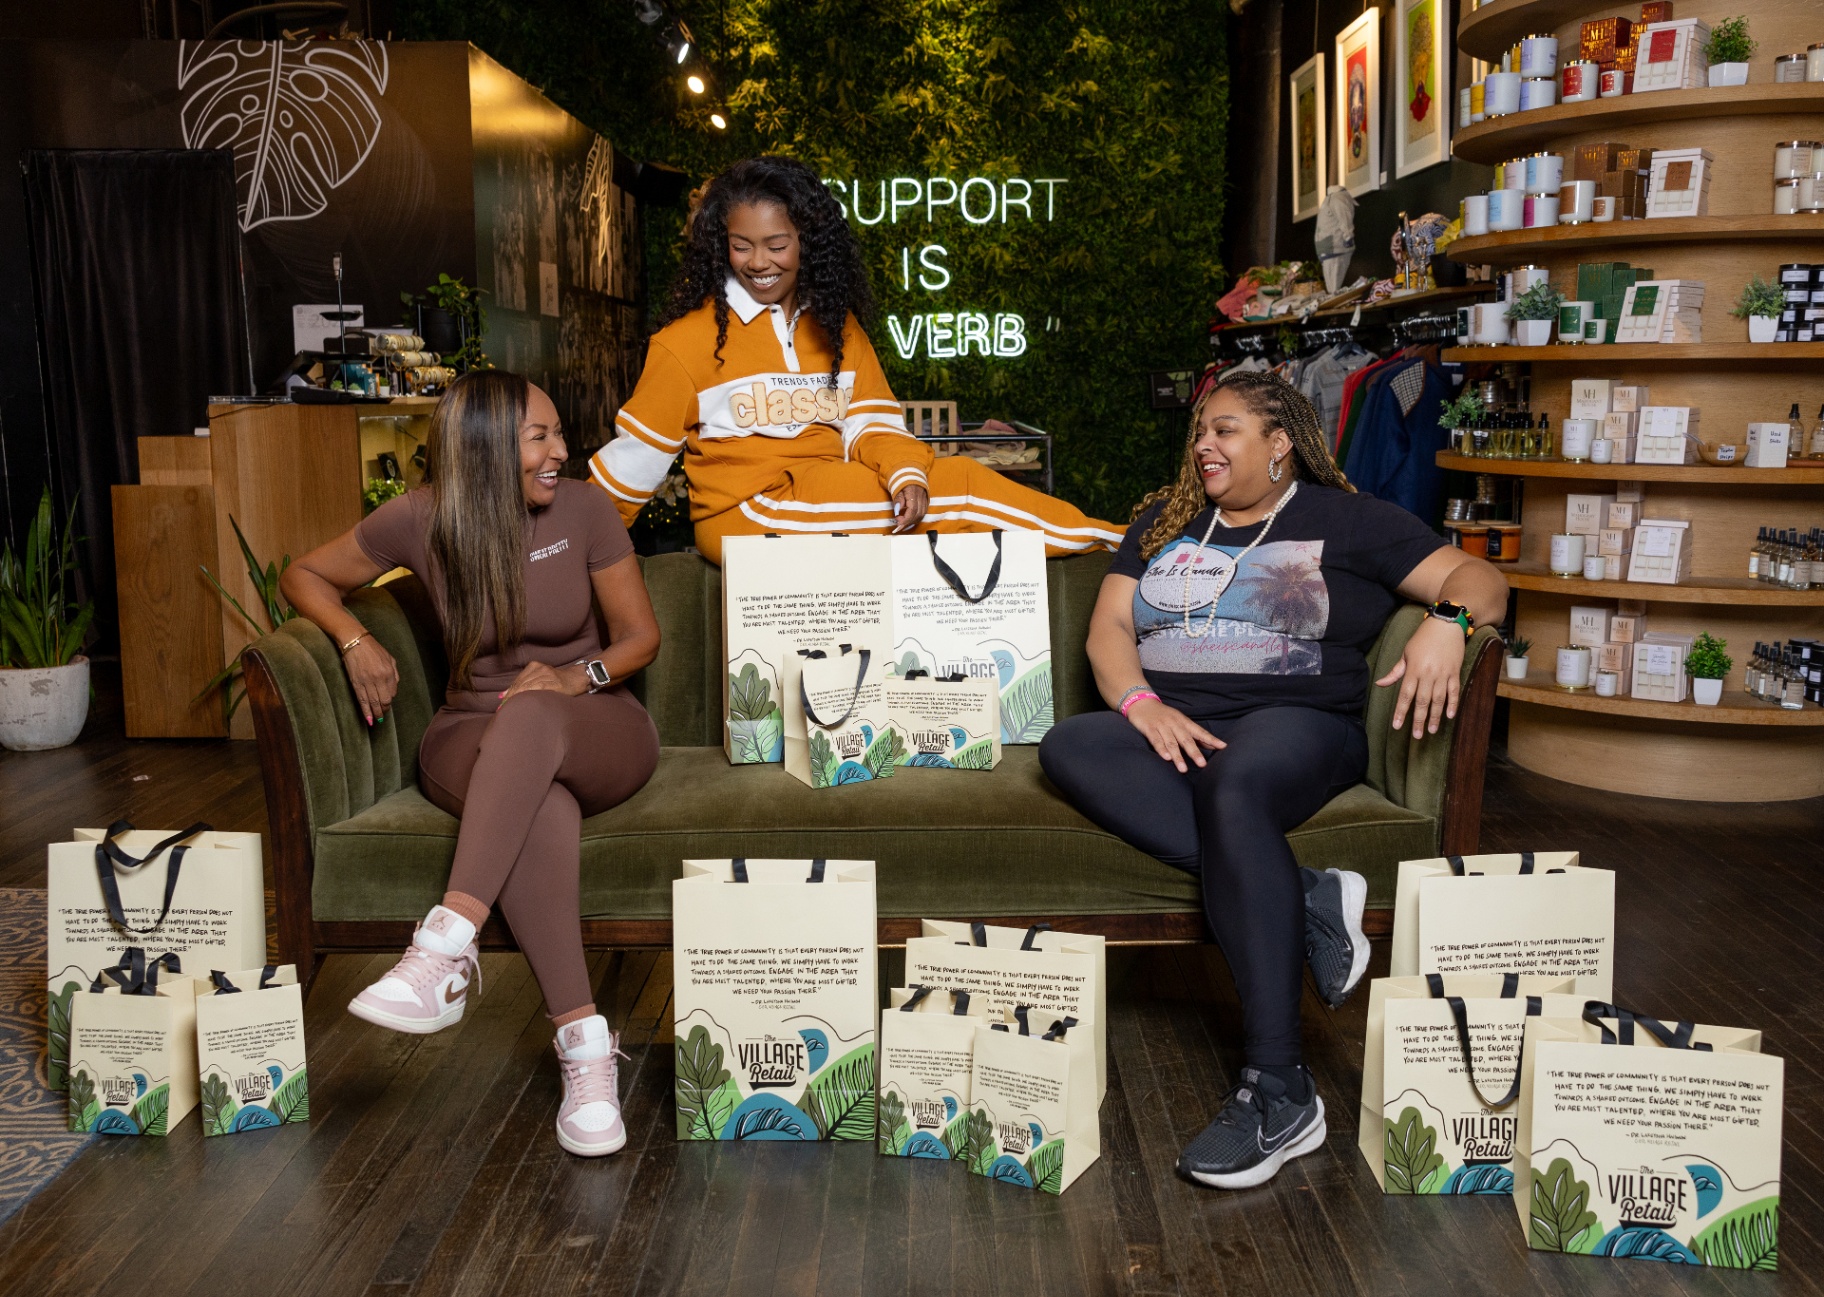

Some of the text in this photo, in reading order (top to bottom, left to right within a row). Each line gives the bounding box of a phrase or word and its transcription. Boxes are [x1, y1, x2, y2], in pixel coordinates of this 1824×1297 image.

[903, 244, 950, 291] IS
[771, 377, 808, 386] TRENDS
[1146, 566, 1166, 578] She
[1166, 565, 1178, 577] Is
[836, 734, 864, 750] VILLAGE
[912, 733, 950, 747] VILLAGE
[918, 742, 944, 752] Retail
[738, 1043, 804, 1071] VILLAGE
[749, 1063, 796, 1082] Retail
[102, 1080, 135, 1096] VILLAGE
[235, 1075, 270, 1094] VILLAGE
[1616, 1073, 1658, 1081] COMMUNITY
[1738, 1081, 1754, 1090] DOES
[106, 1090, 129, 1102] Retail
[242, 1088, 266, 1099] Retail
[1679, 1089, 1705, 1099] SIMPLY
[912, 1102, 945, 1119] VILLAGE
[1649, 1096, 1679, 1105] ENGAGE
[1695, 1100, 1711, 1108] THE
[1714, 1104, 1736, 1112] AREA
[1740, 1106, 1761, 1115] THAT
[917, 1113, 940, 1124] Retail
[1655, 1121, 1681, 1129] PASSION
[999, 1124, 1030, 1146] VILLAGE
[1464, 1138, 1512, 1159] Retail
[1640, 1165, 1654, 1174] The
[1608, 1174, 1687, 1212] VILLAGE
[1620, 1197, 1677, 1221] Retail
